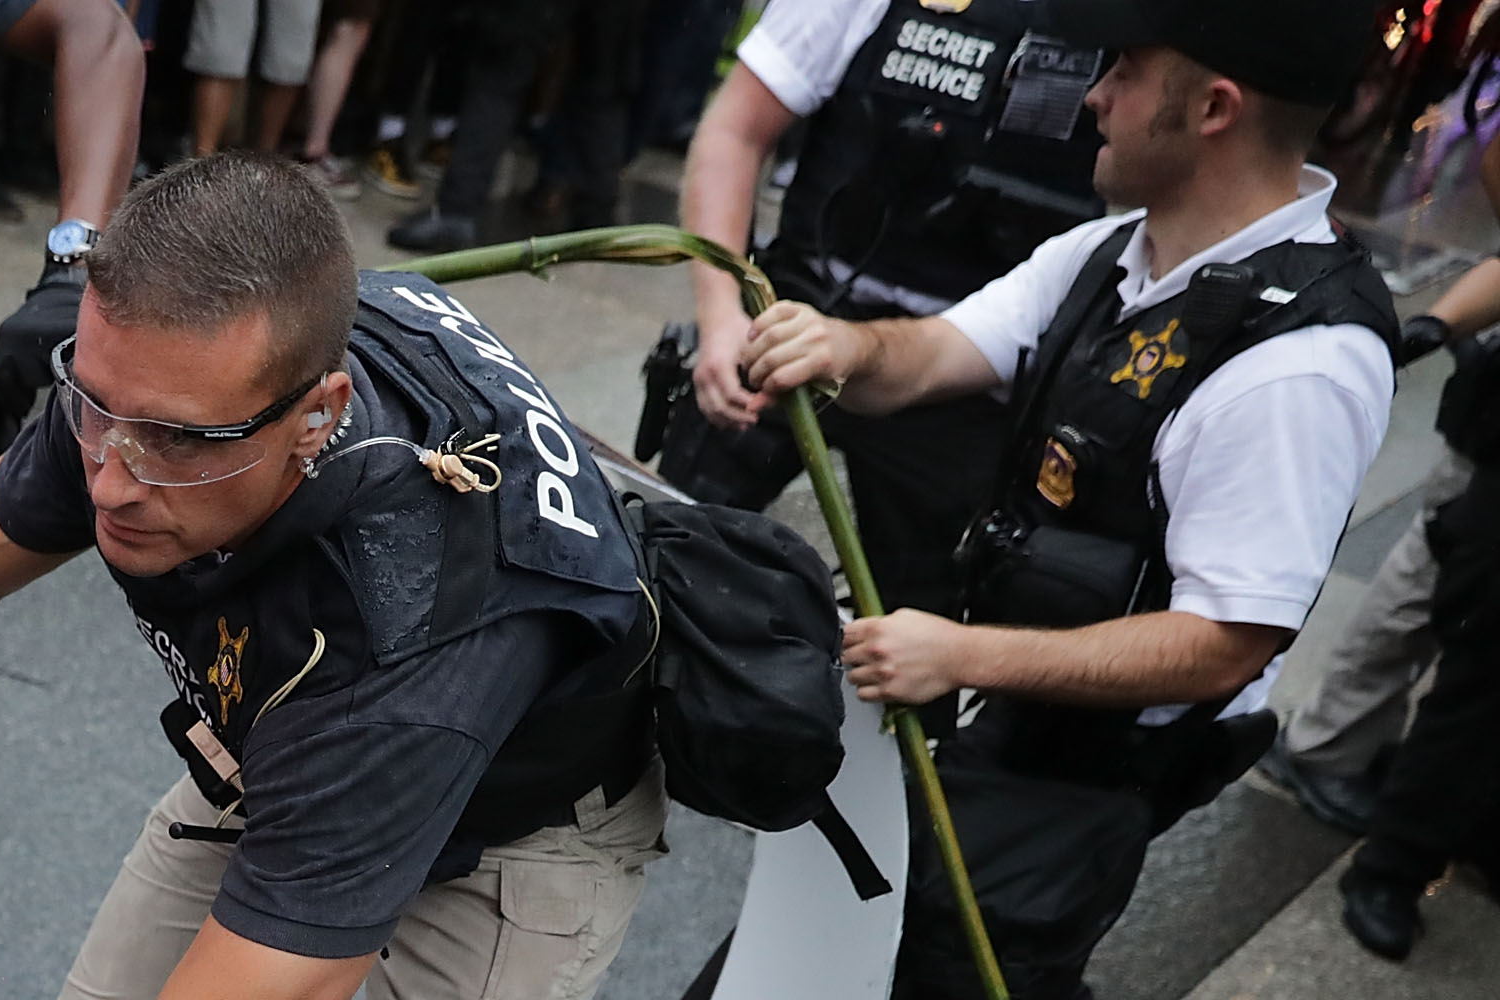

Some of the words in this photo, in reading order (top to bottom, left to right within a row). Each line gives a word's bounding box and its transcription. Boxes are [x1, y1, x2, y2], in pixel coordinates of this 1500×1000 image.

[896, 19, 996, 69] SECRET
[880, 49, 986, 102] SERVICE
[392, 286, 599, 539] POLICE
